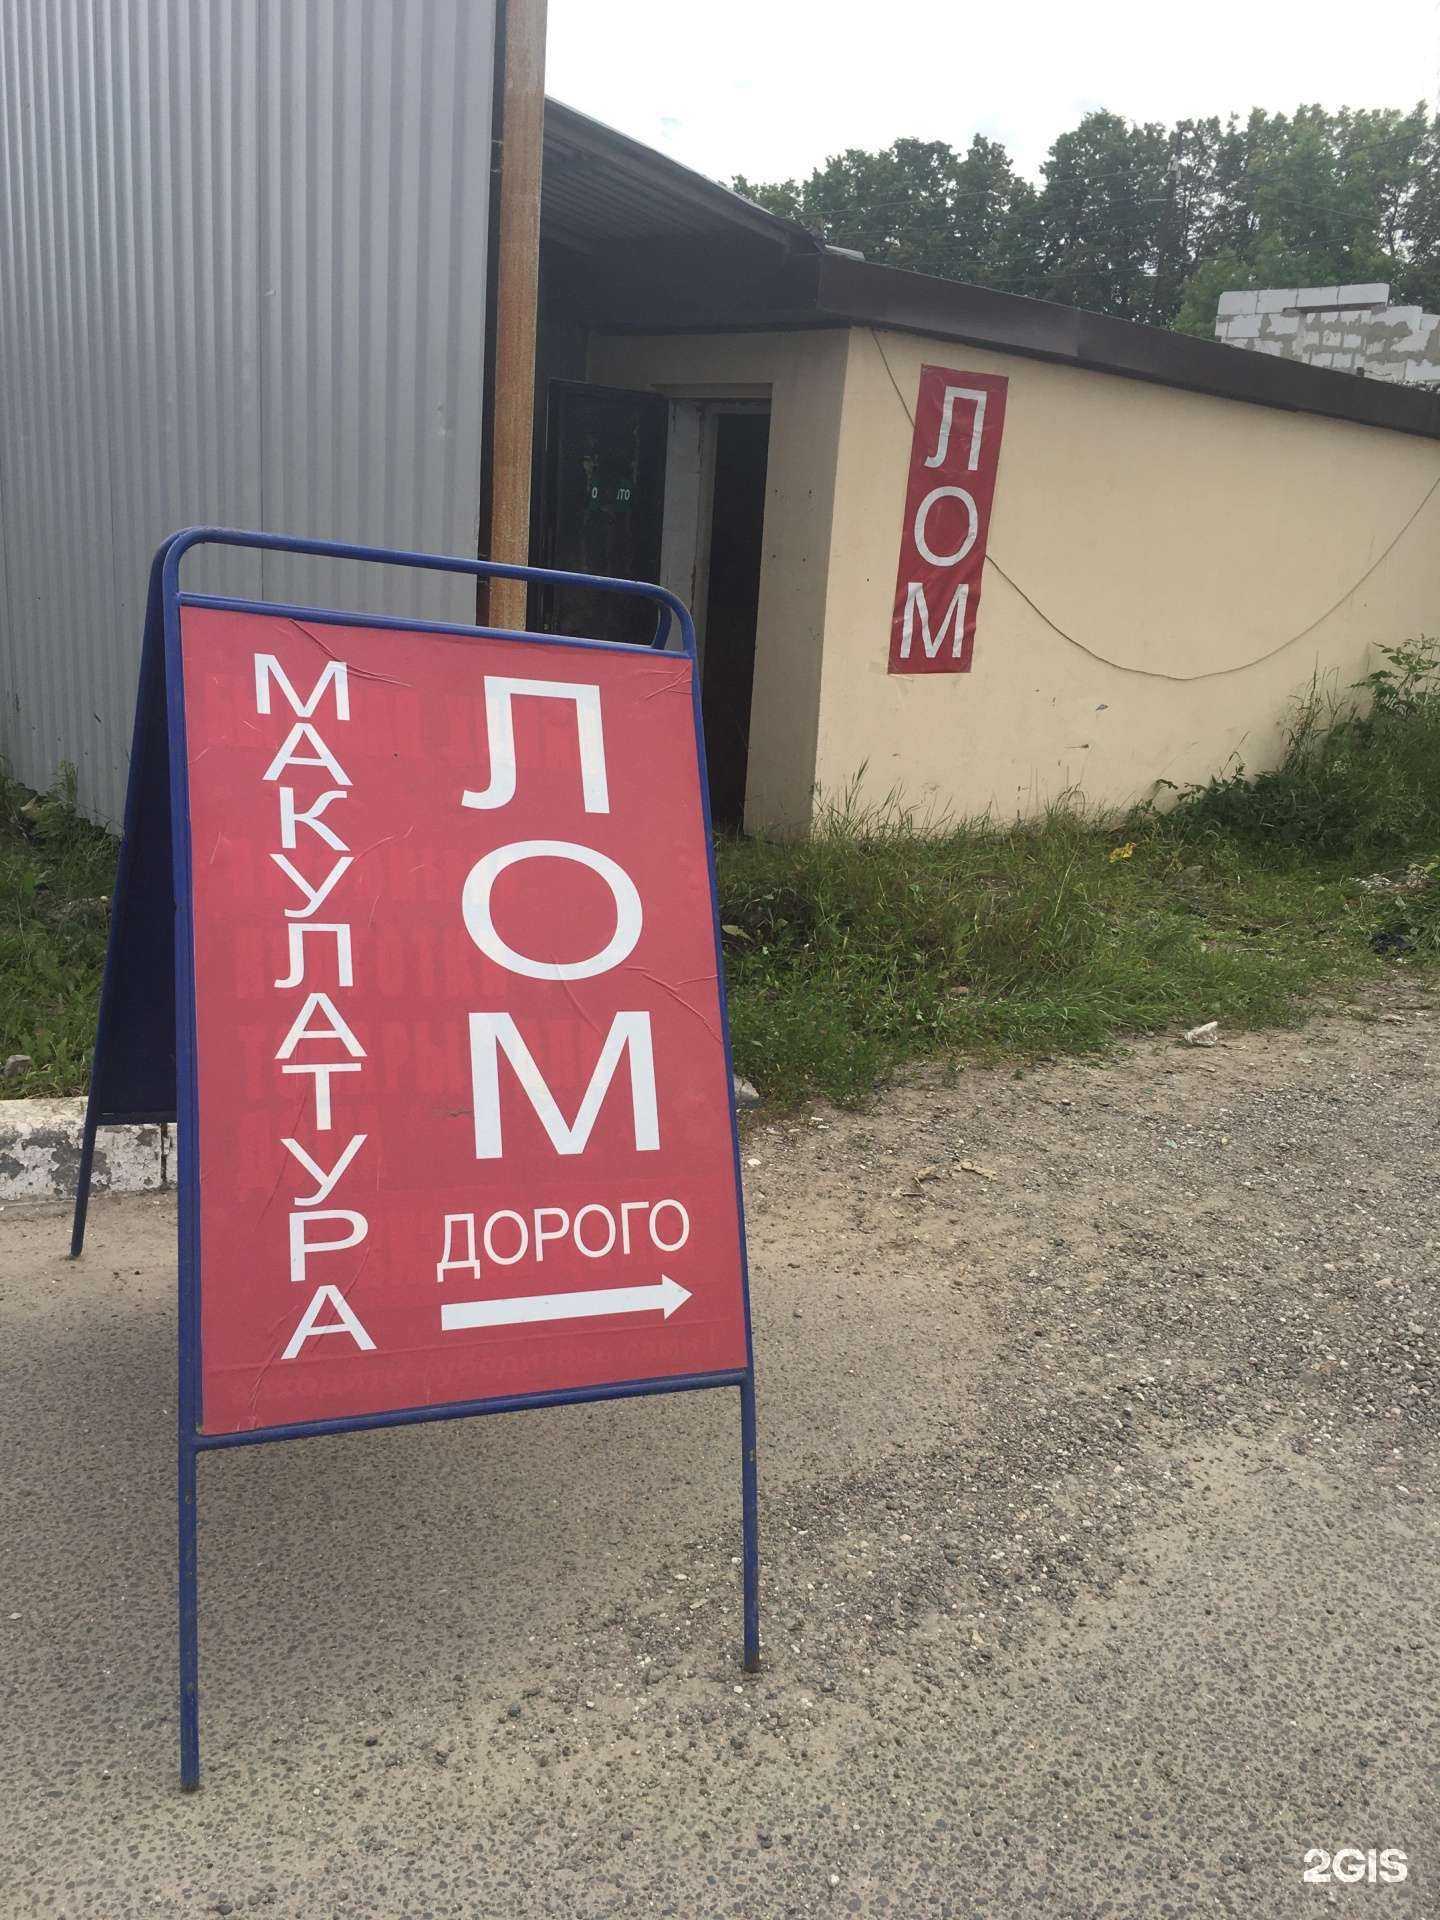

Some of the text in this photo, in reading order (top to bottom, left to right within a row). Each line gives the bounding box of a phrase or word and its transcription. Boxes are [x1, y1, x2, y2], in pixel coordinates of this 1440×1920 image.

[900, 386, 987, 658] ЛОМ
[254, 653, 376, 1359] МАКУЛАТУРА
[461, 676, 660, 1159] ЛОМ
[437, 1199, 690, 1282] ДОРОГО
